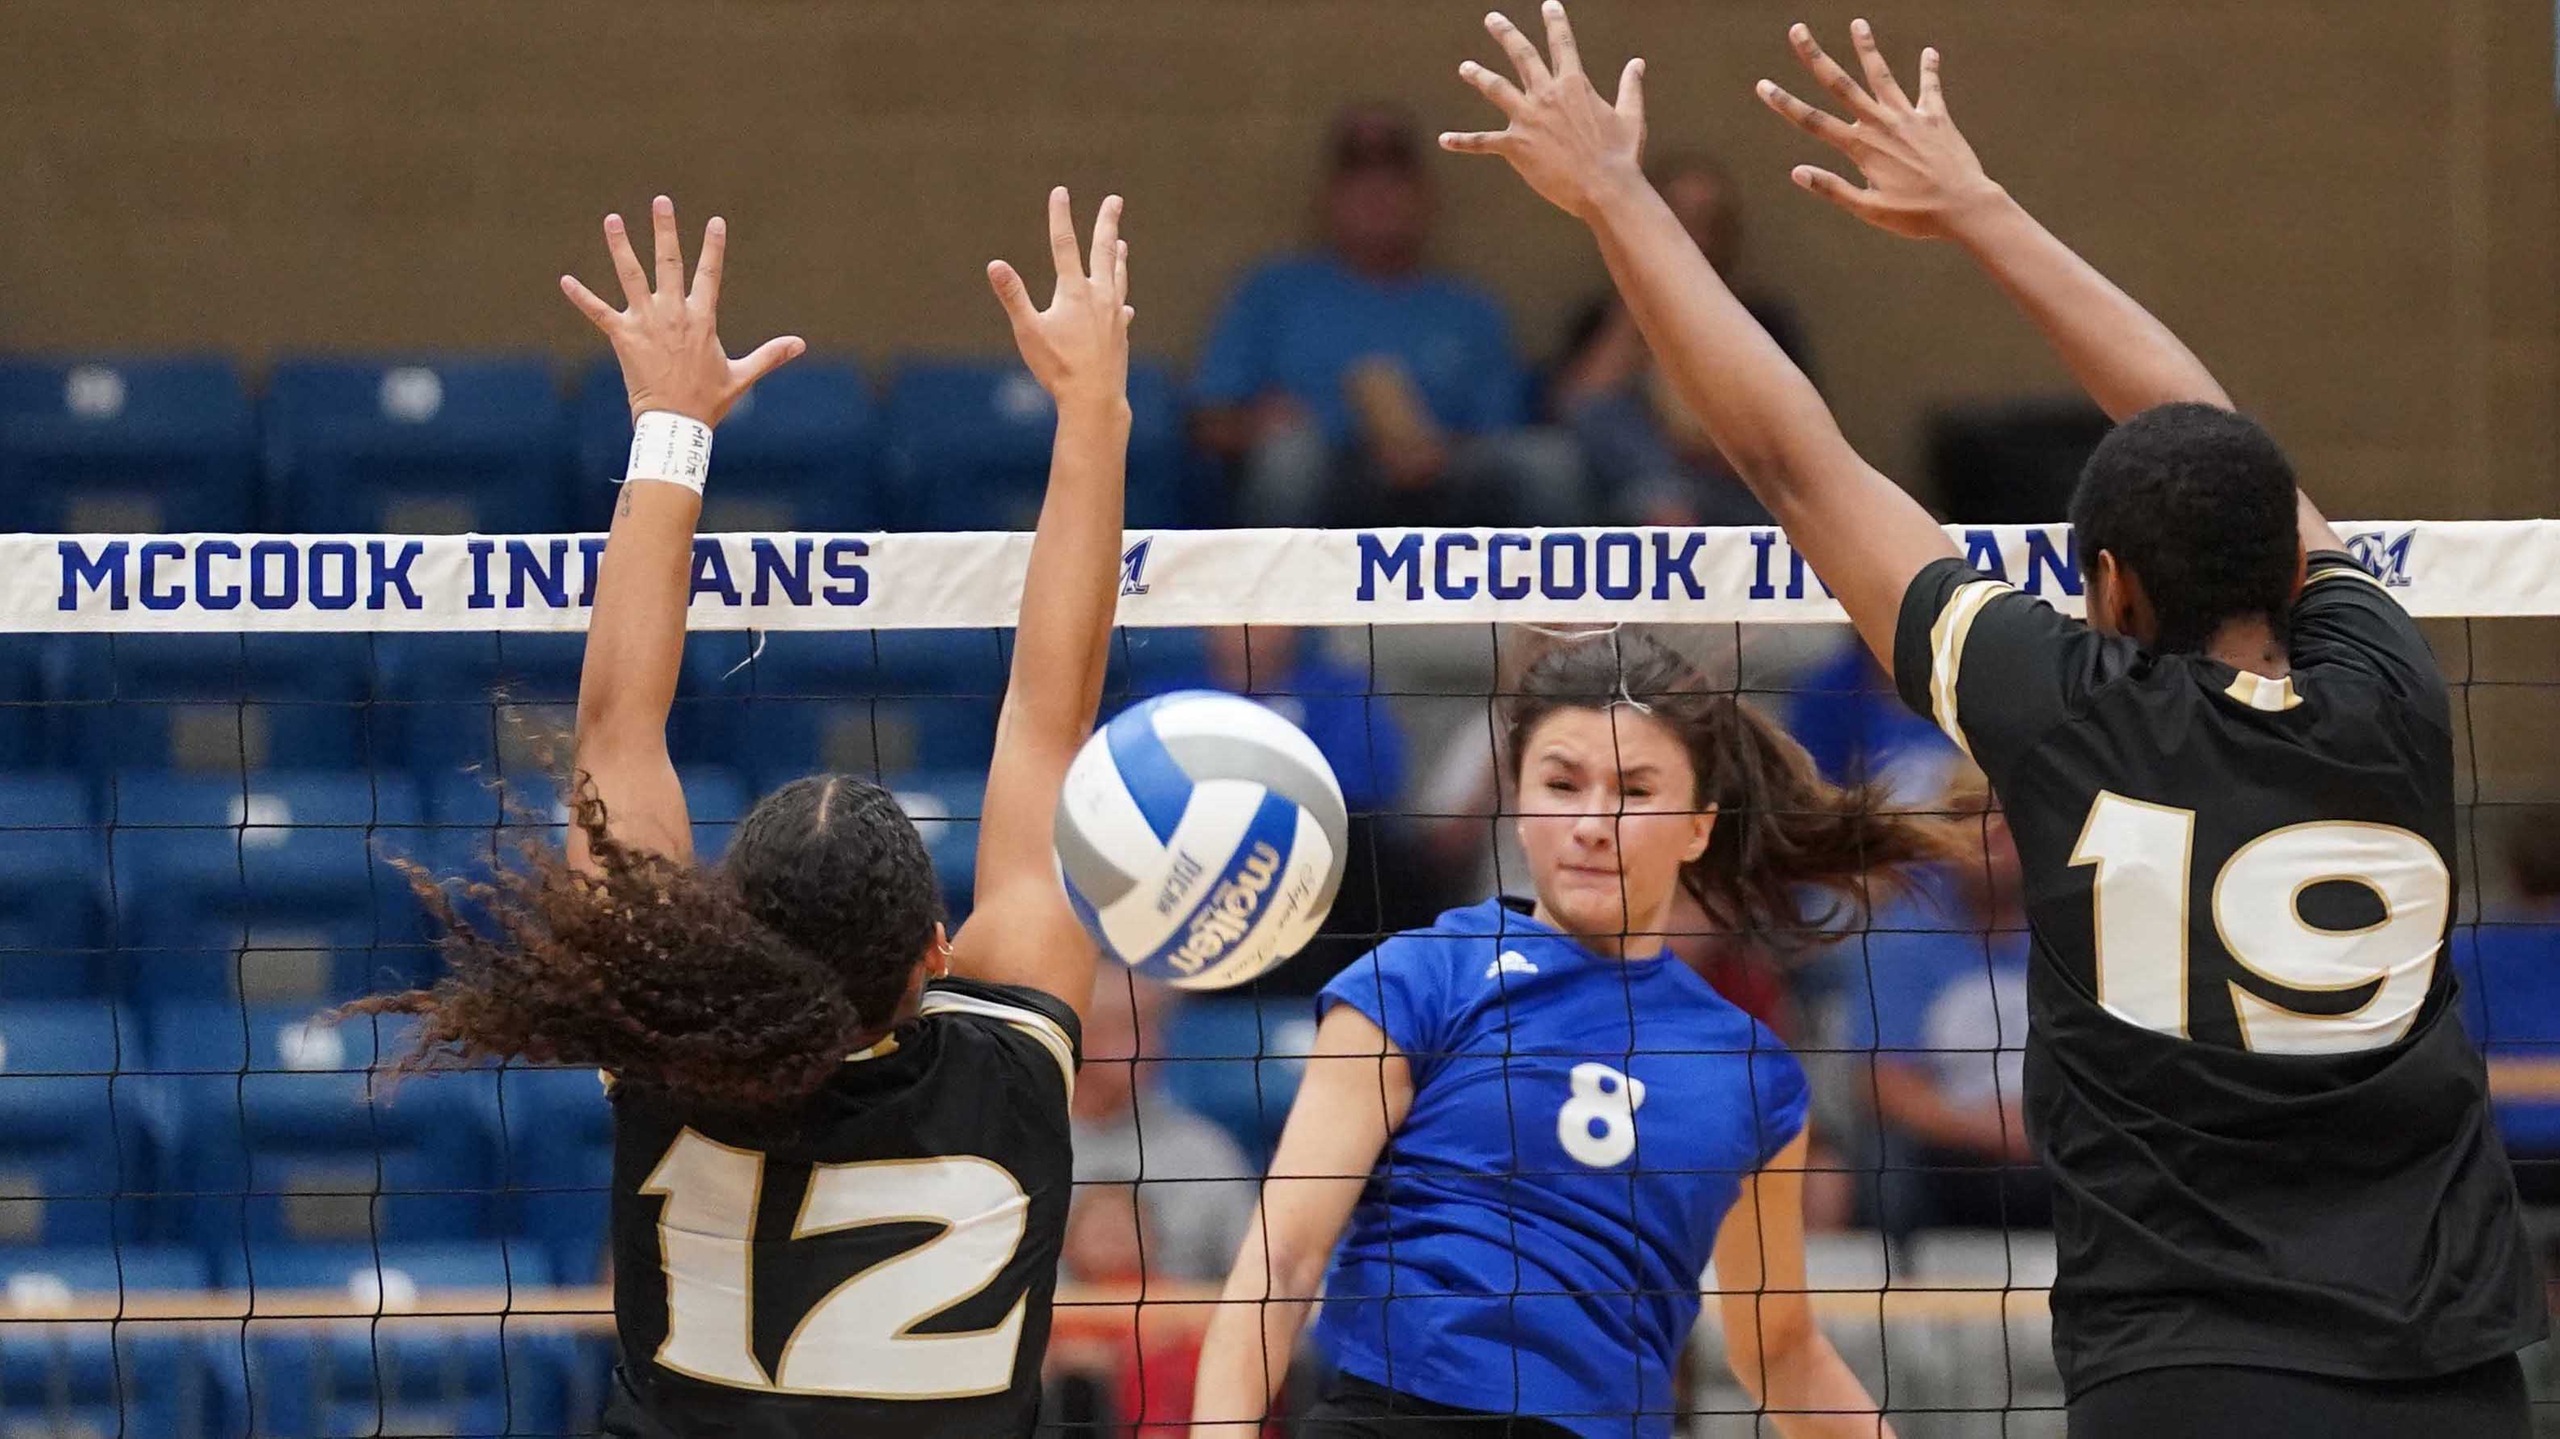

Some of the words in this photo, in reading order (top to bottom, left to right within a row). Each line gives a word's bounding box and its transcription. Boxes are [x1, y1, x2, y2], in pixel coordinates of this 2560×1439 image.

[58, 540, 423, 611] MCCOOK
[467, 538, 870, 609] INANS
[1356, 532, 1706, 601] MCCOOK
[1167, 839, 1280, 976] molten
[2067, 789, 2450, 1055] 19
[1557, 1062, 1646, 1168] 8
[637, 1125, 1031, 1401] 12
